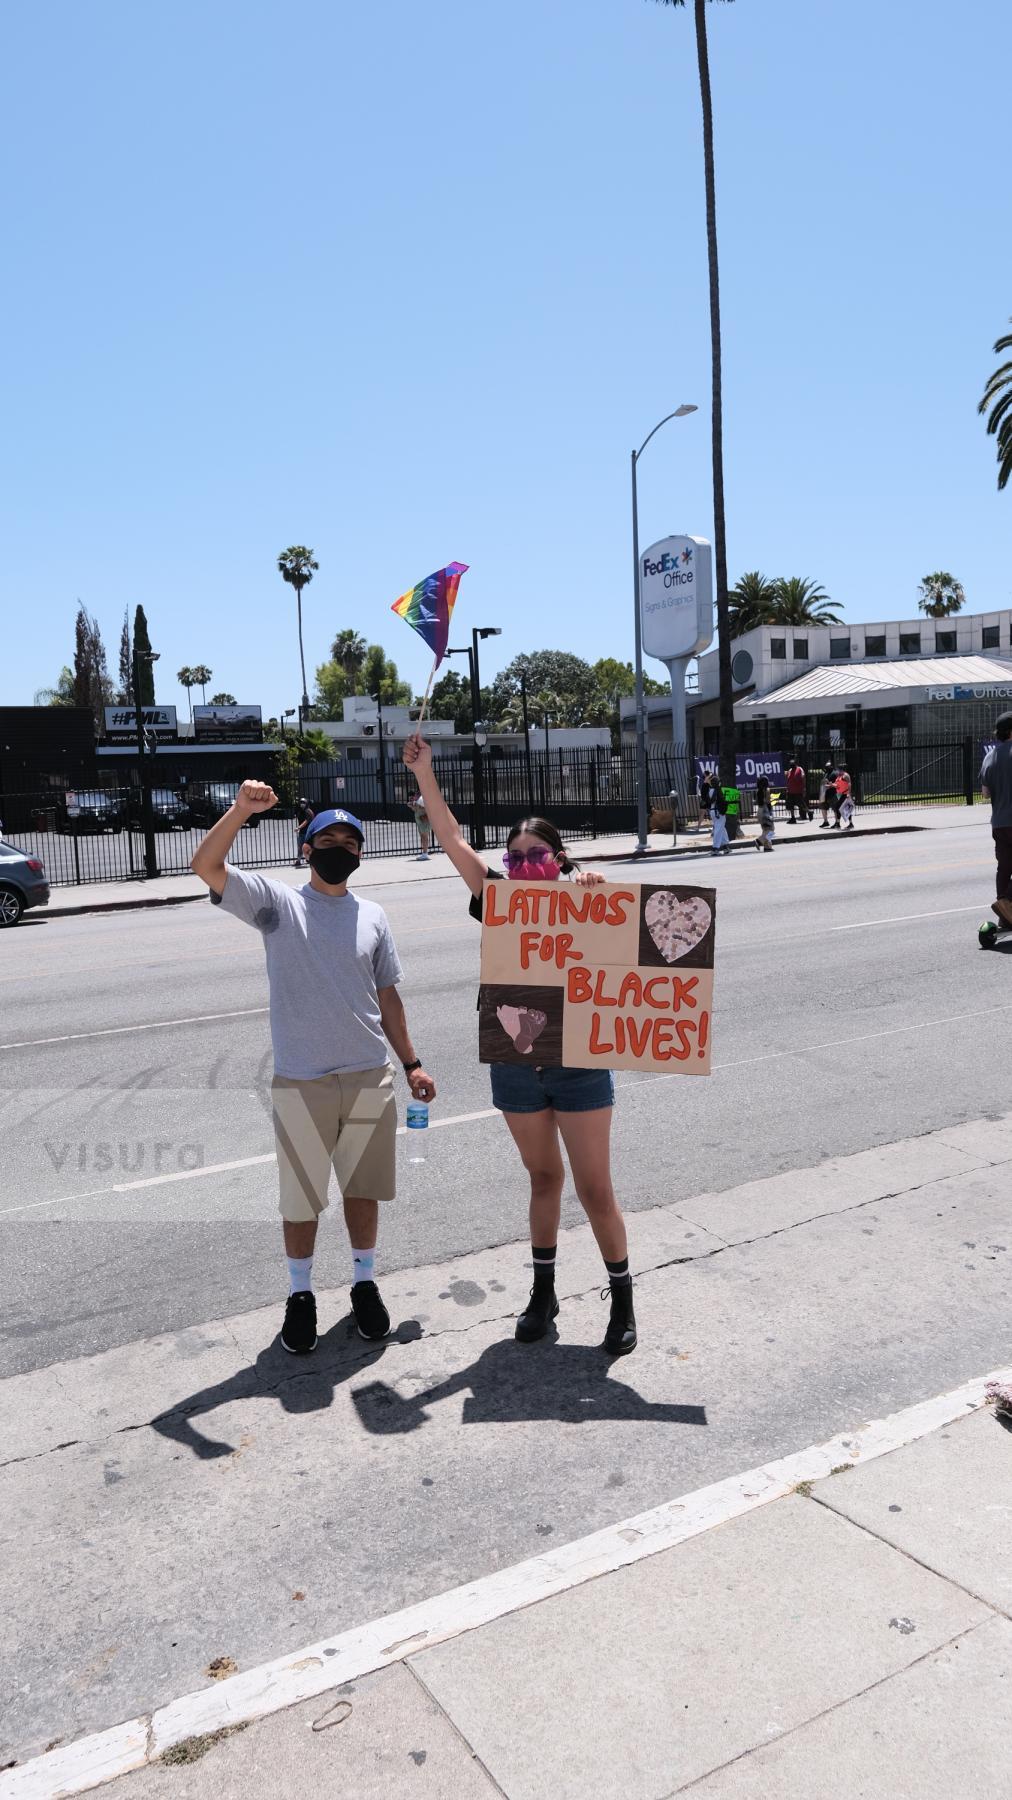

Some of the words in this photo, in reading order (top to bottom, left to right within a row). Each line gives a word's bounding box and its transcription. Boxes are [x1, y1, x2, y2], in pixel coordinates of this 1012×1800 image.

[643, 552, 680, 578] FedEx
[663, 570, 694, 589] Office
[744, 758, 781, 778] Open
[334, 809, 348, 821] LA
[484, 884, 636, 927] LATINOS
[520, 932, 584, 969] FOR
[567, 966, 699, 1012] BLACK
[589, 1010, 709, 1061] LIVES!
